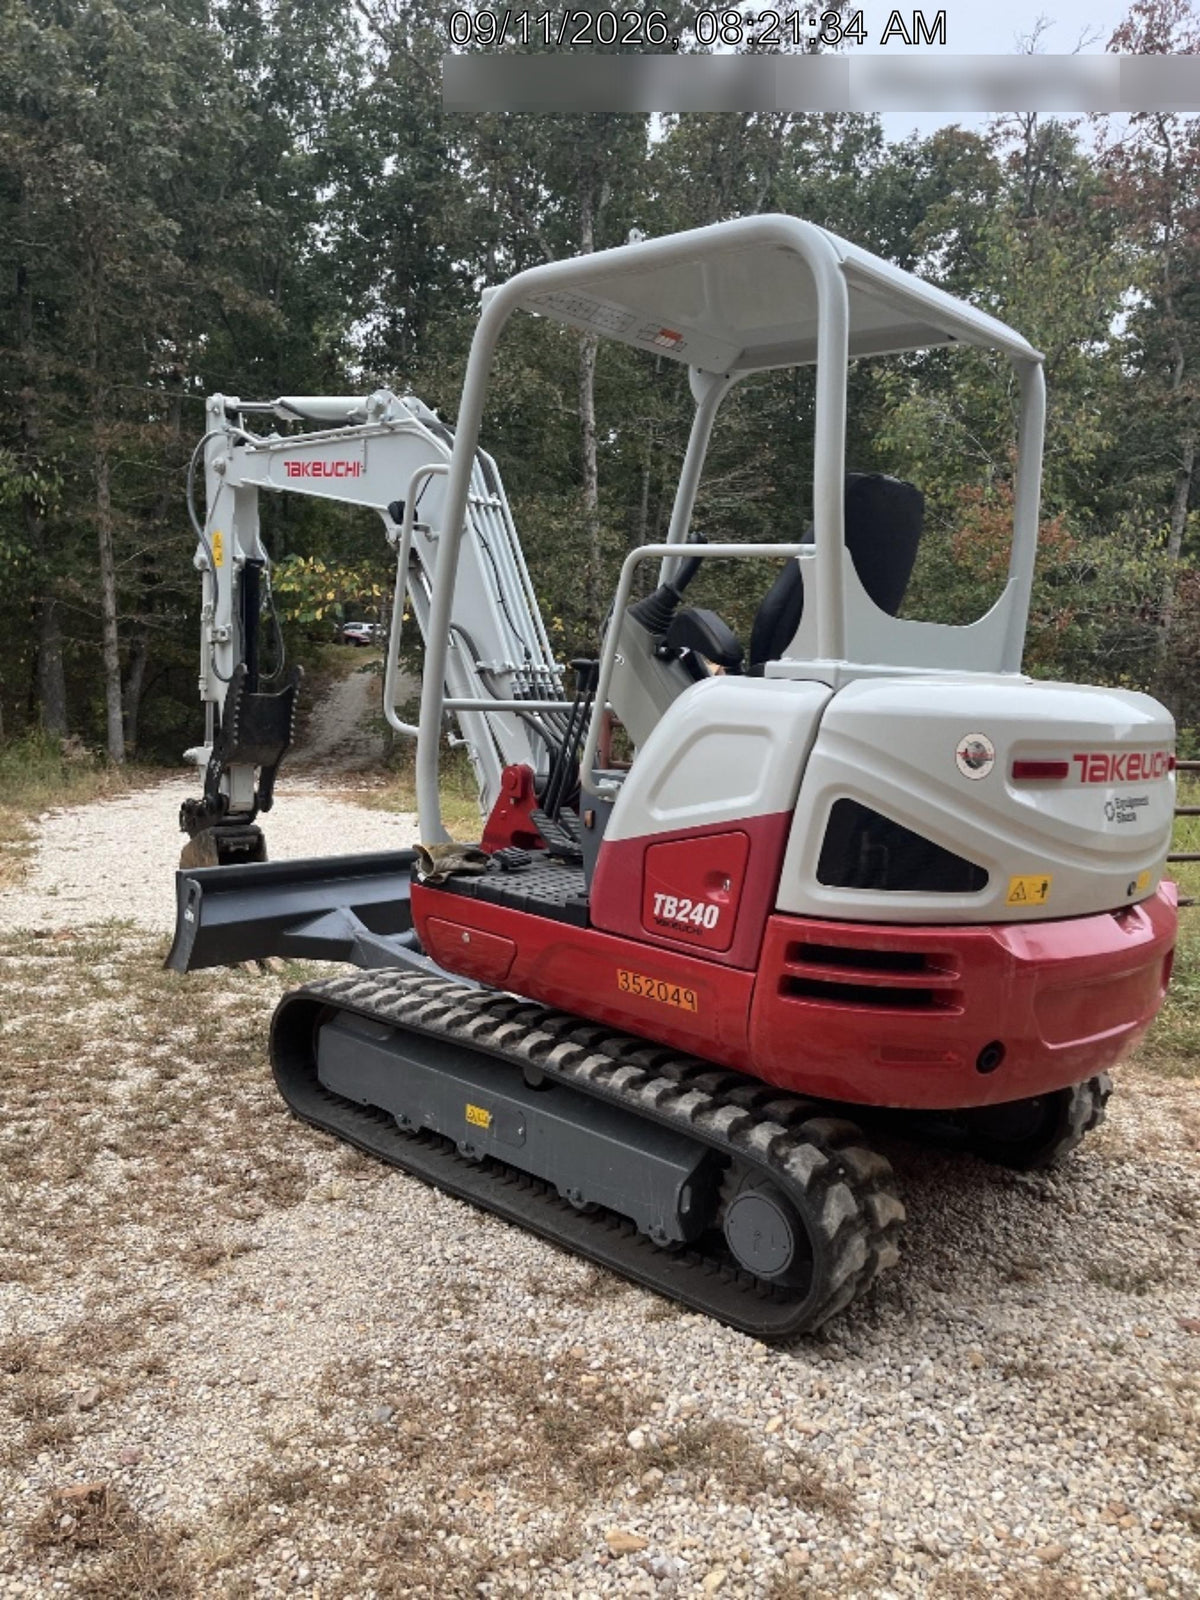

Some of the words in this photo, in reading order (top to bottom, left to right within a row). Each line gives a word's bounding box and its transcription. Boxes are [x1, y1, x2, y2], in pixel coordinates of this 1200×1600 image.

[284, 461, 360, 477] TAKEUCHI
[654, 892, 720, 929] TB240
[620, 972, 696, 1010] 352049
